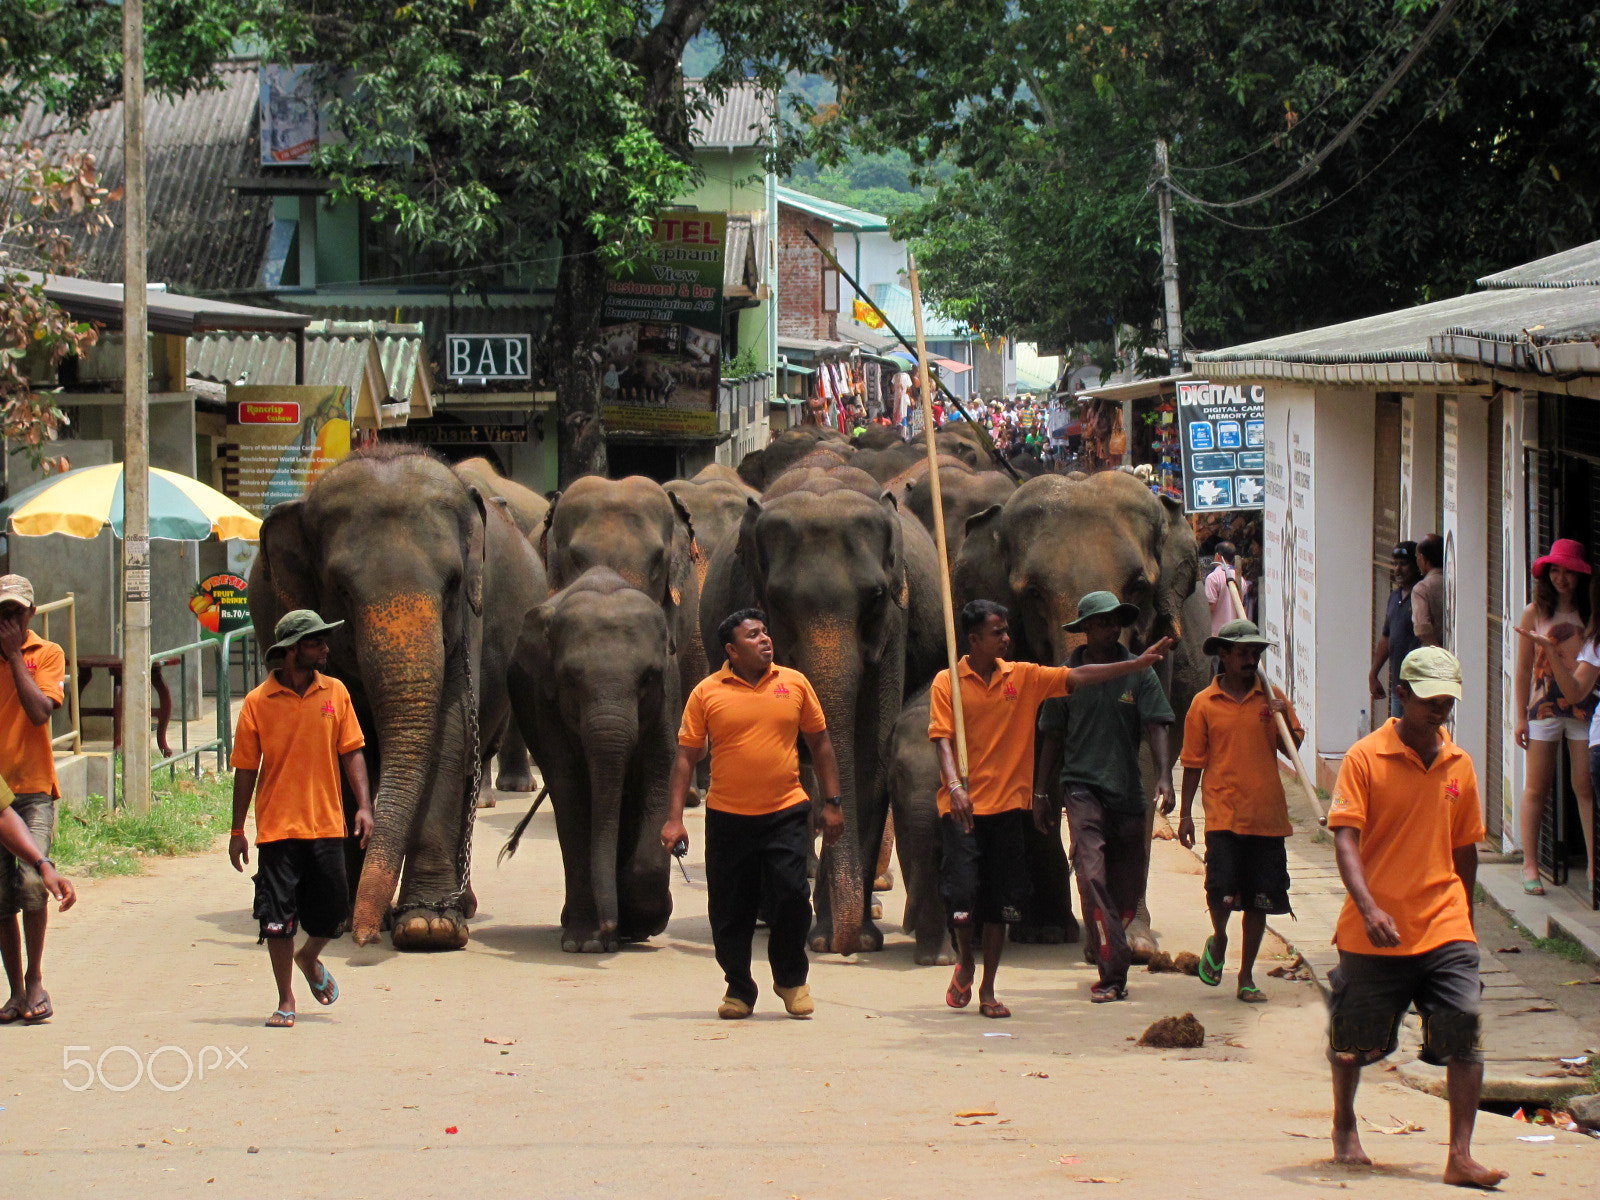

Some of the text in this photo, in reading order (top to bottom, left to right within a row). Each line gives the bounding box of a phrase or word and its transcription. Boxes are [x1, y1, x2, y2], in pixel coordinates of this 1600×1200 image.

[651, 264, 700, 282] View
[606, 280, 717, 298] Restaurant & Bar
[604, 295, 693, 310] Accommodation
[650, 309, 674, 321] Hall
[451, 338, 526, 375] BAR
[1179, 384, 1265, 406] DIGITAL C
[1203, 406, 1239, 414] DIGITAL
[1207, 412, 1247, 420] MEMORY
[483, 425, 527, 441] View
[201, 574, 249, 592] FRESH
[212, 590, 235, 598] FRUIT
